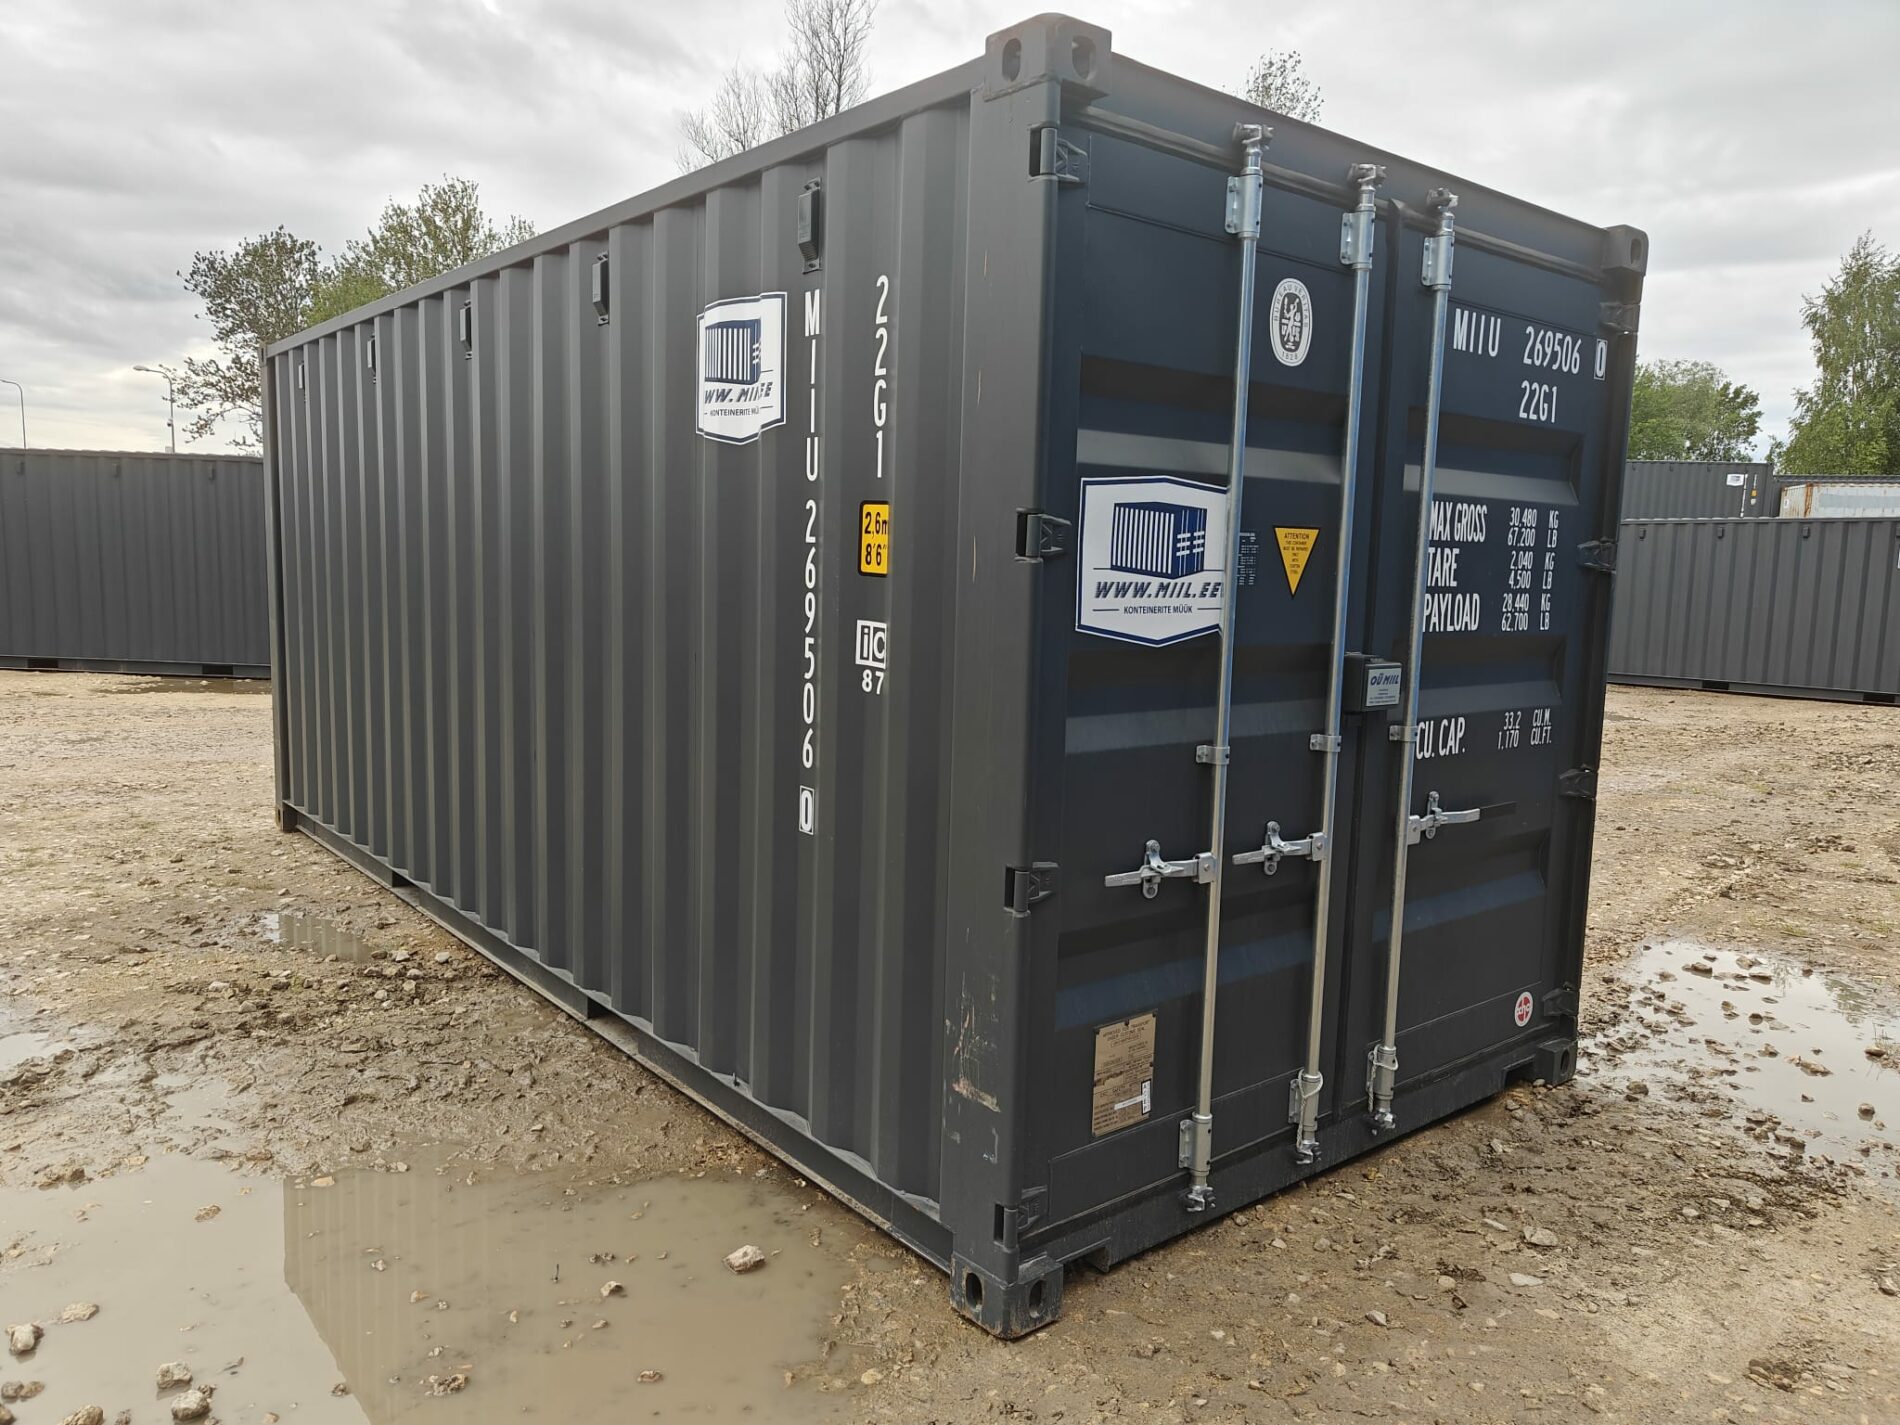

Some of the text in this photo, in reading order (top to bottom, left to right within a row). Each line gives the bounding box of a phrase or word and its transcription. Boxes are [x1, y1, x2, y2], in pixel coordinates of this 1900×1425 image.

[1453, 308, 1608, 379] MIIU 269506 0
[873, 274, 889, 478] 22G1
[1519, 380, 1557, 423] 22G1
[1284, 532, 1310, 540] ATTENTION
[1429, 501, 1453, 541] MAX
[1454, 503, 1488, 542] GROSS
[1548, 510, 1559, 529] KG
[1547, 529, 1558, 548] LB
[801, 288, 820, 833] MIIU 269506 0
[1428, 547, 1459, 587] TARE
[1544, 552, 1555, 570] KG
[1542, 571, 1553, 589] LB
[1095, 581, 1222, 599] WWW.MIIL.EE
[1123, 603, 1193, 615] KONTEINERITE MÜÜK
[1423, 593, 1480, 632] PAYLOAD
[1540, 593, 1551, 611] KG
[1539, 612, 1550, 630] LB
[861, 669, 885, 695] 87
[1416, 720, 1435, 759] CU.
[1439, 716, 1466, 756] CAP.
[1503, 711, 1522, 730] 33.2
